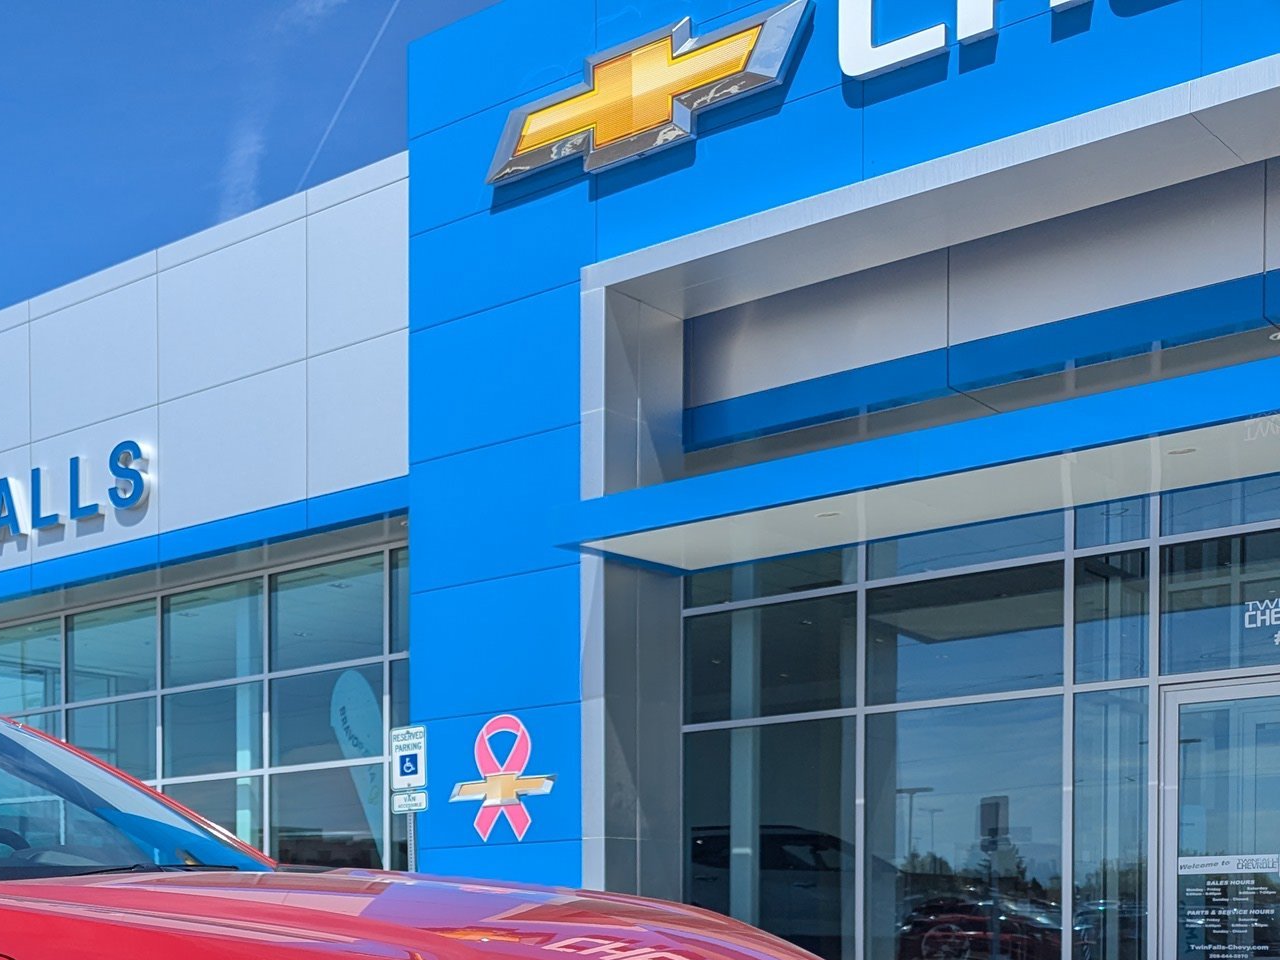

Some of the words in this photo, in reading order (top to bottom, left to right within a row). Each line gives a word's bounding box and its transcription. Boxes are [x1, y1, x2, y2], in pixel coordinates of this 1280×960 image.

[393, 731, 424, 742] RESERVED
[395, 742, 422, 752] PARKING
[1180, 861, 1218, 870] Welcome
